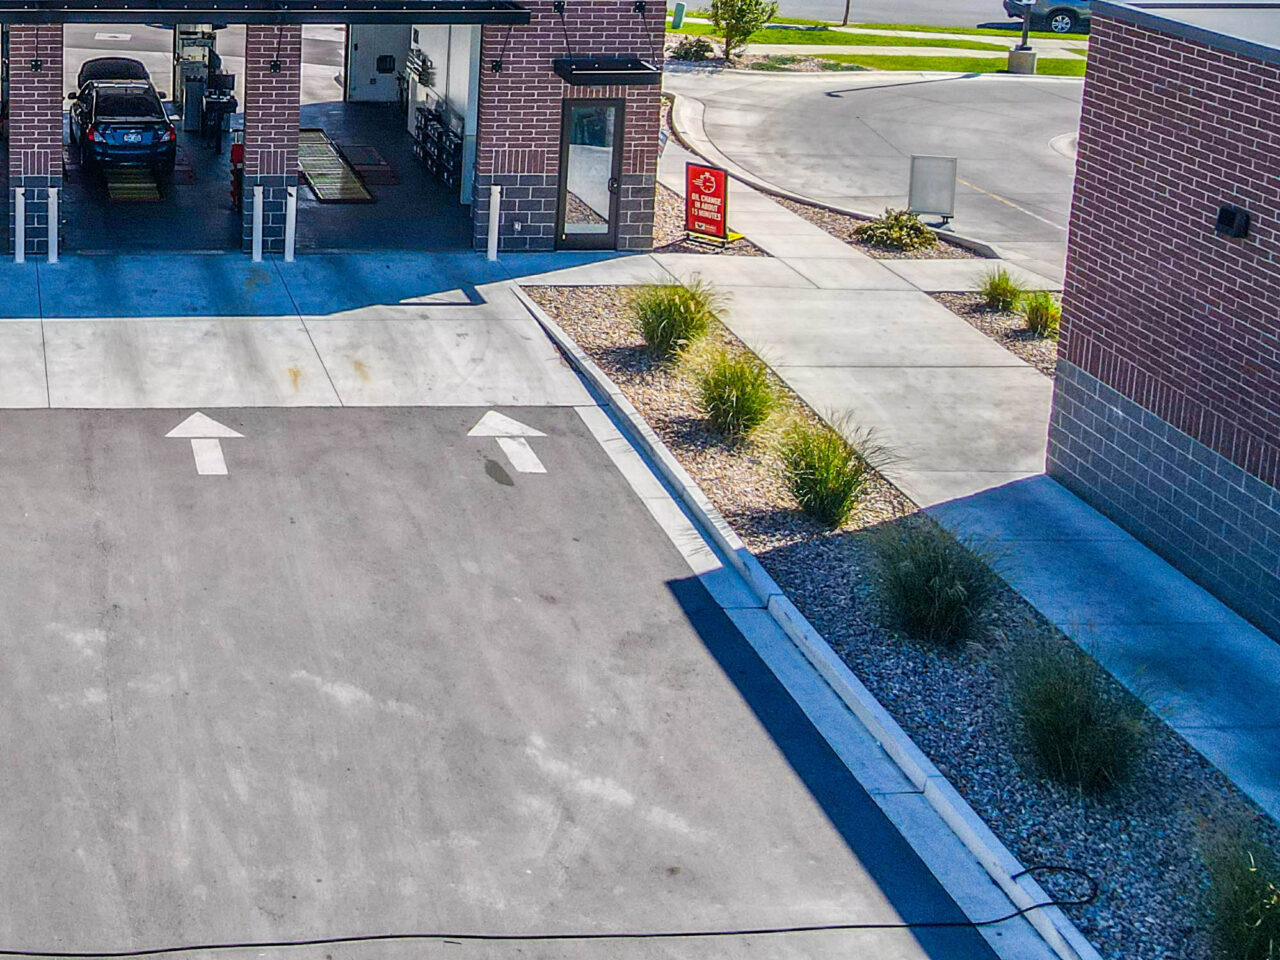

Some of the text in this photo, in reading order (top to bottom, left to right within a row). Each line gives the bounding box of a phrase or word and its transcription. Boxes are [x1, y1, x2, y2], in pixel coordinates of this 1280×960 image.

[692, 192, 721, 206] OIL CHANGE
[692, 208, 721, 220] 15 MINUTES
